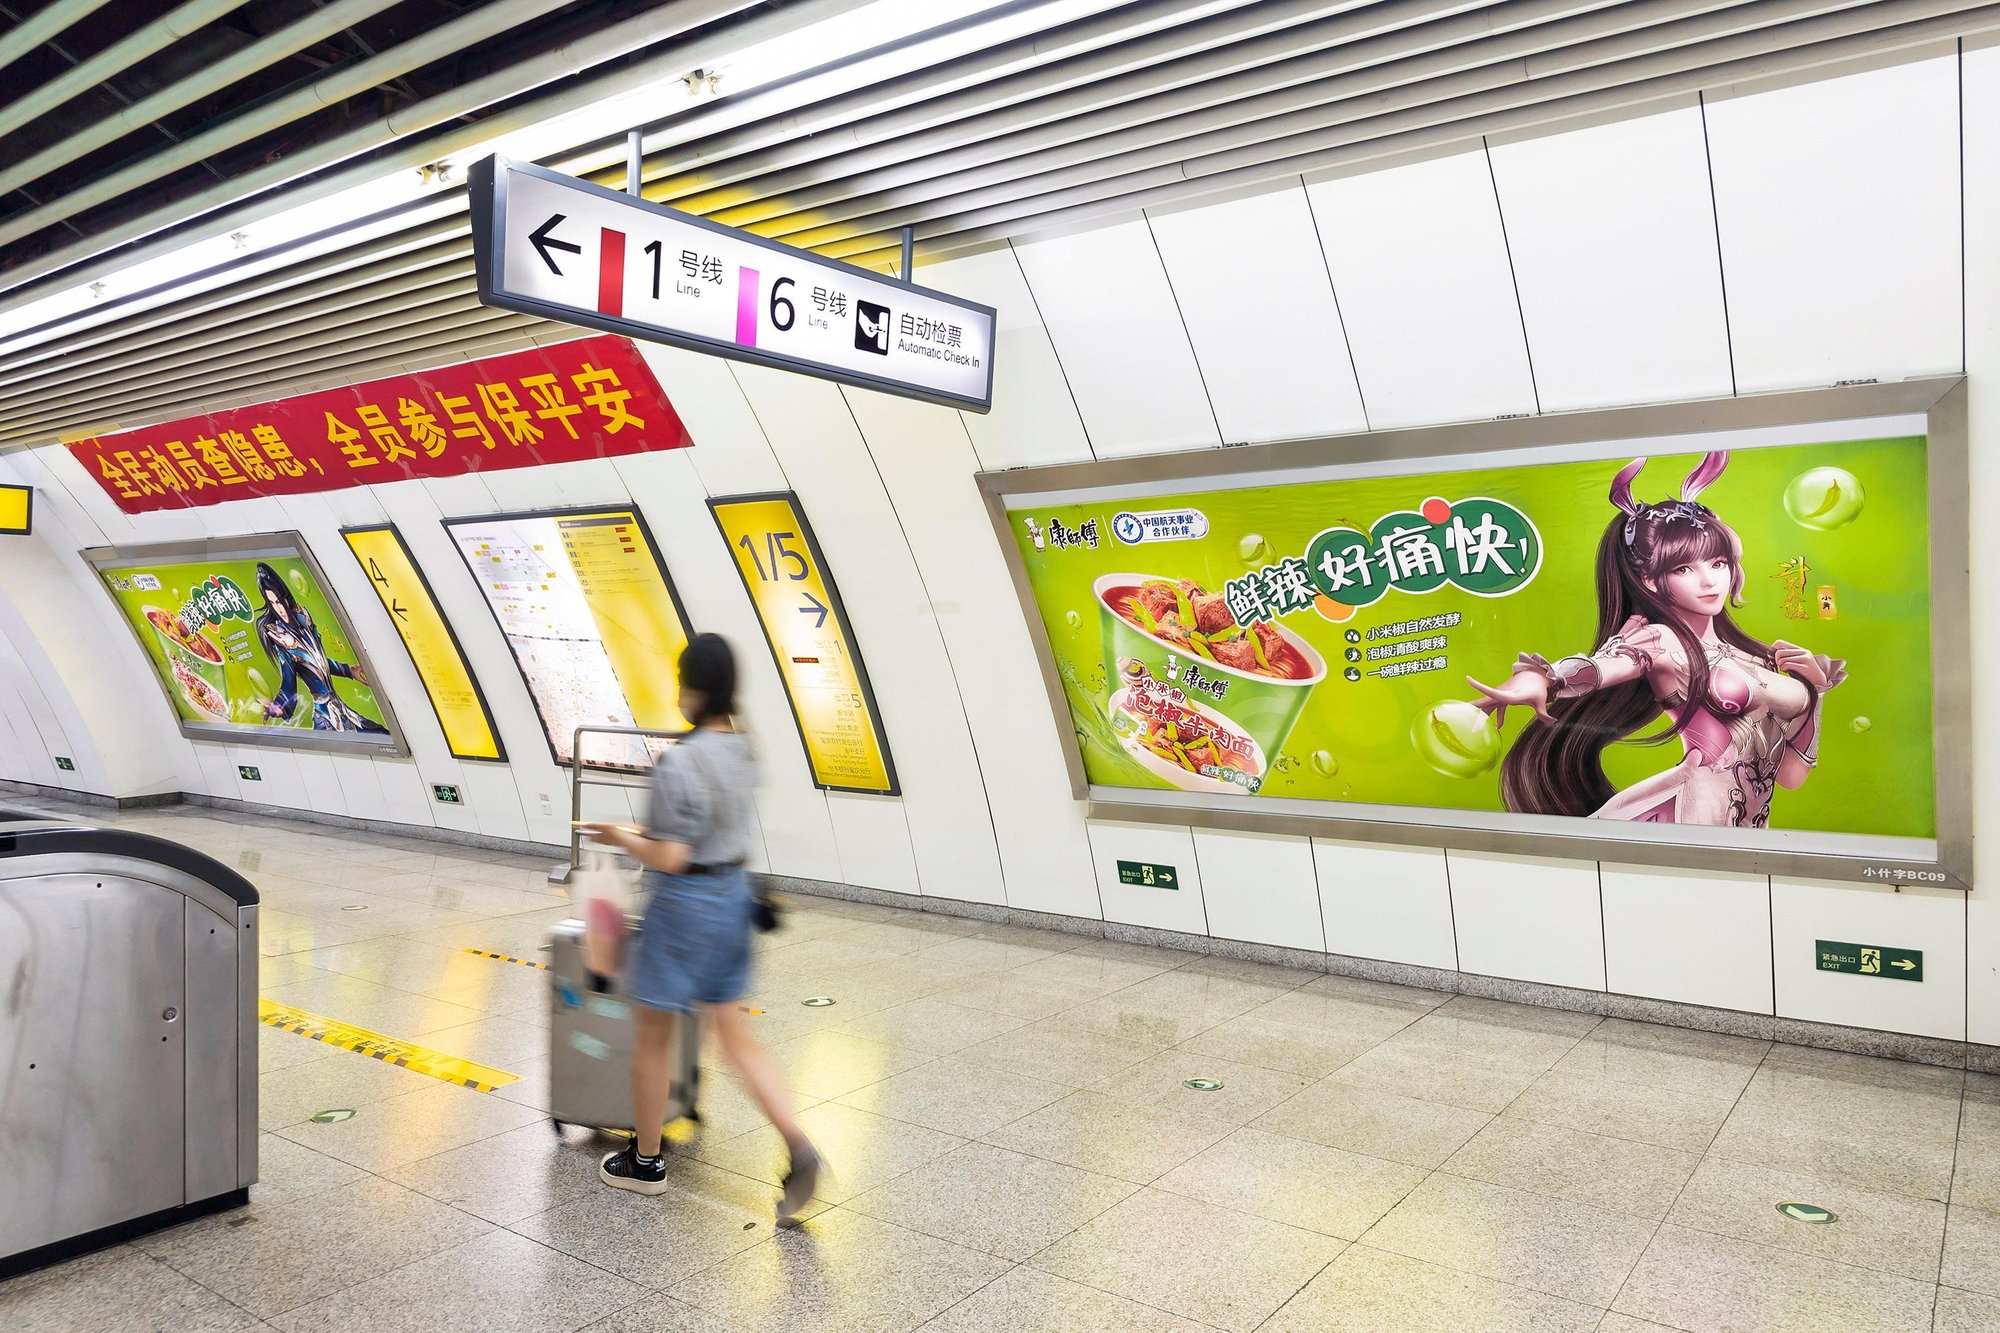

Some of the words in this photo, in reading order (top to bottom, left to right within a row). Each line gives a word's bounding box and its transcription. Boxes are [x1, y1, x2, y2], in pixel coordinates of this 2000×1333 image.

[644, 240, 662, 300] 1
[679, 249, 723, 285] 号线
[676, 280, 701, 298] Line
[770, 276, 796, 332] 6
[810, 286, 847, 318] 号线
[808, 314, 829, 330] Line
[900, 312, 963, 349] 自动检票
[897, 338, 942, 361] Automatic
[943, 350, 970, 367] Check
[971, 353, 980, 368] In
[1143, 514, 1194, 527] 中国航天事业
[1153, 525, 1190, 537] 合作伙伴
[738, 532, 810, 581] 1/5
[369, 557, 389, 588] 4
[1366, 612, 1461, 640] 小米椒自然发酵
[834, 640, 842, 654] 1
[1367, 636, 1447, 660] 泡椒清酸爽辣
[1367, 656, 1447, 678] 一碗鲜辣过瘾
[851, 693, 862, 708] 5
[1142, 677, 1185, 702] 小米椒
[1127, 686, 1254, 760] 泡椒牛肉面
[1822, 953, 1856, 964] 紧急出口
[1822, 962, 1841, 970] EXIT
